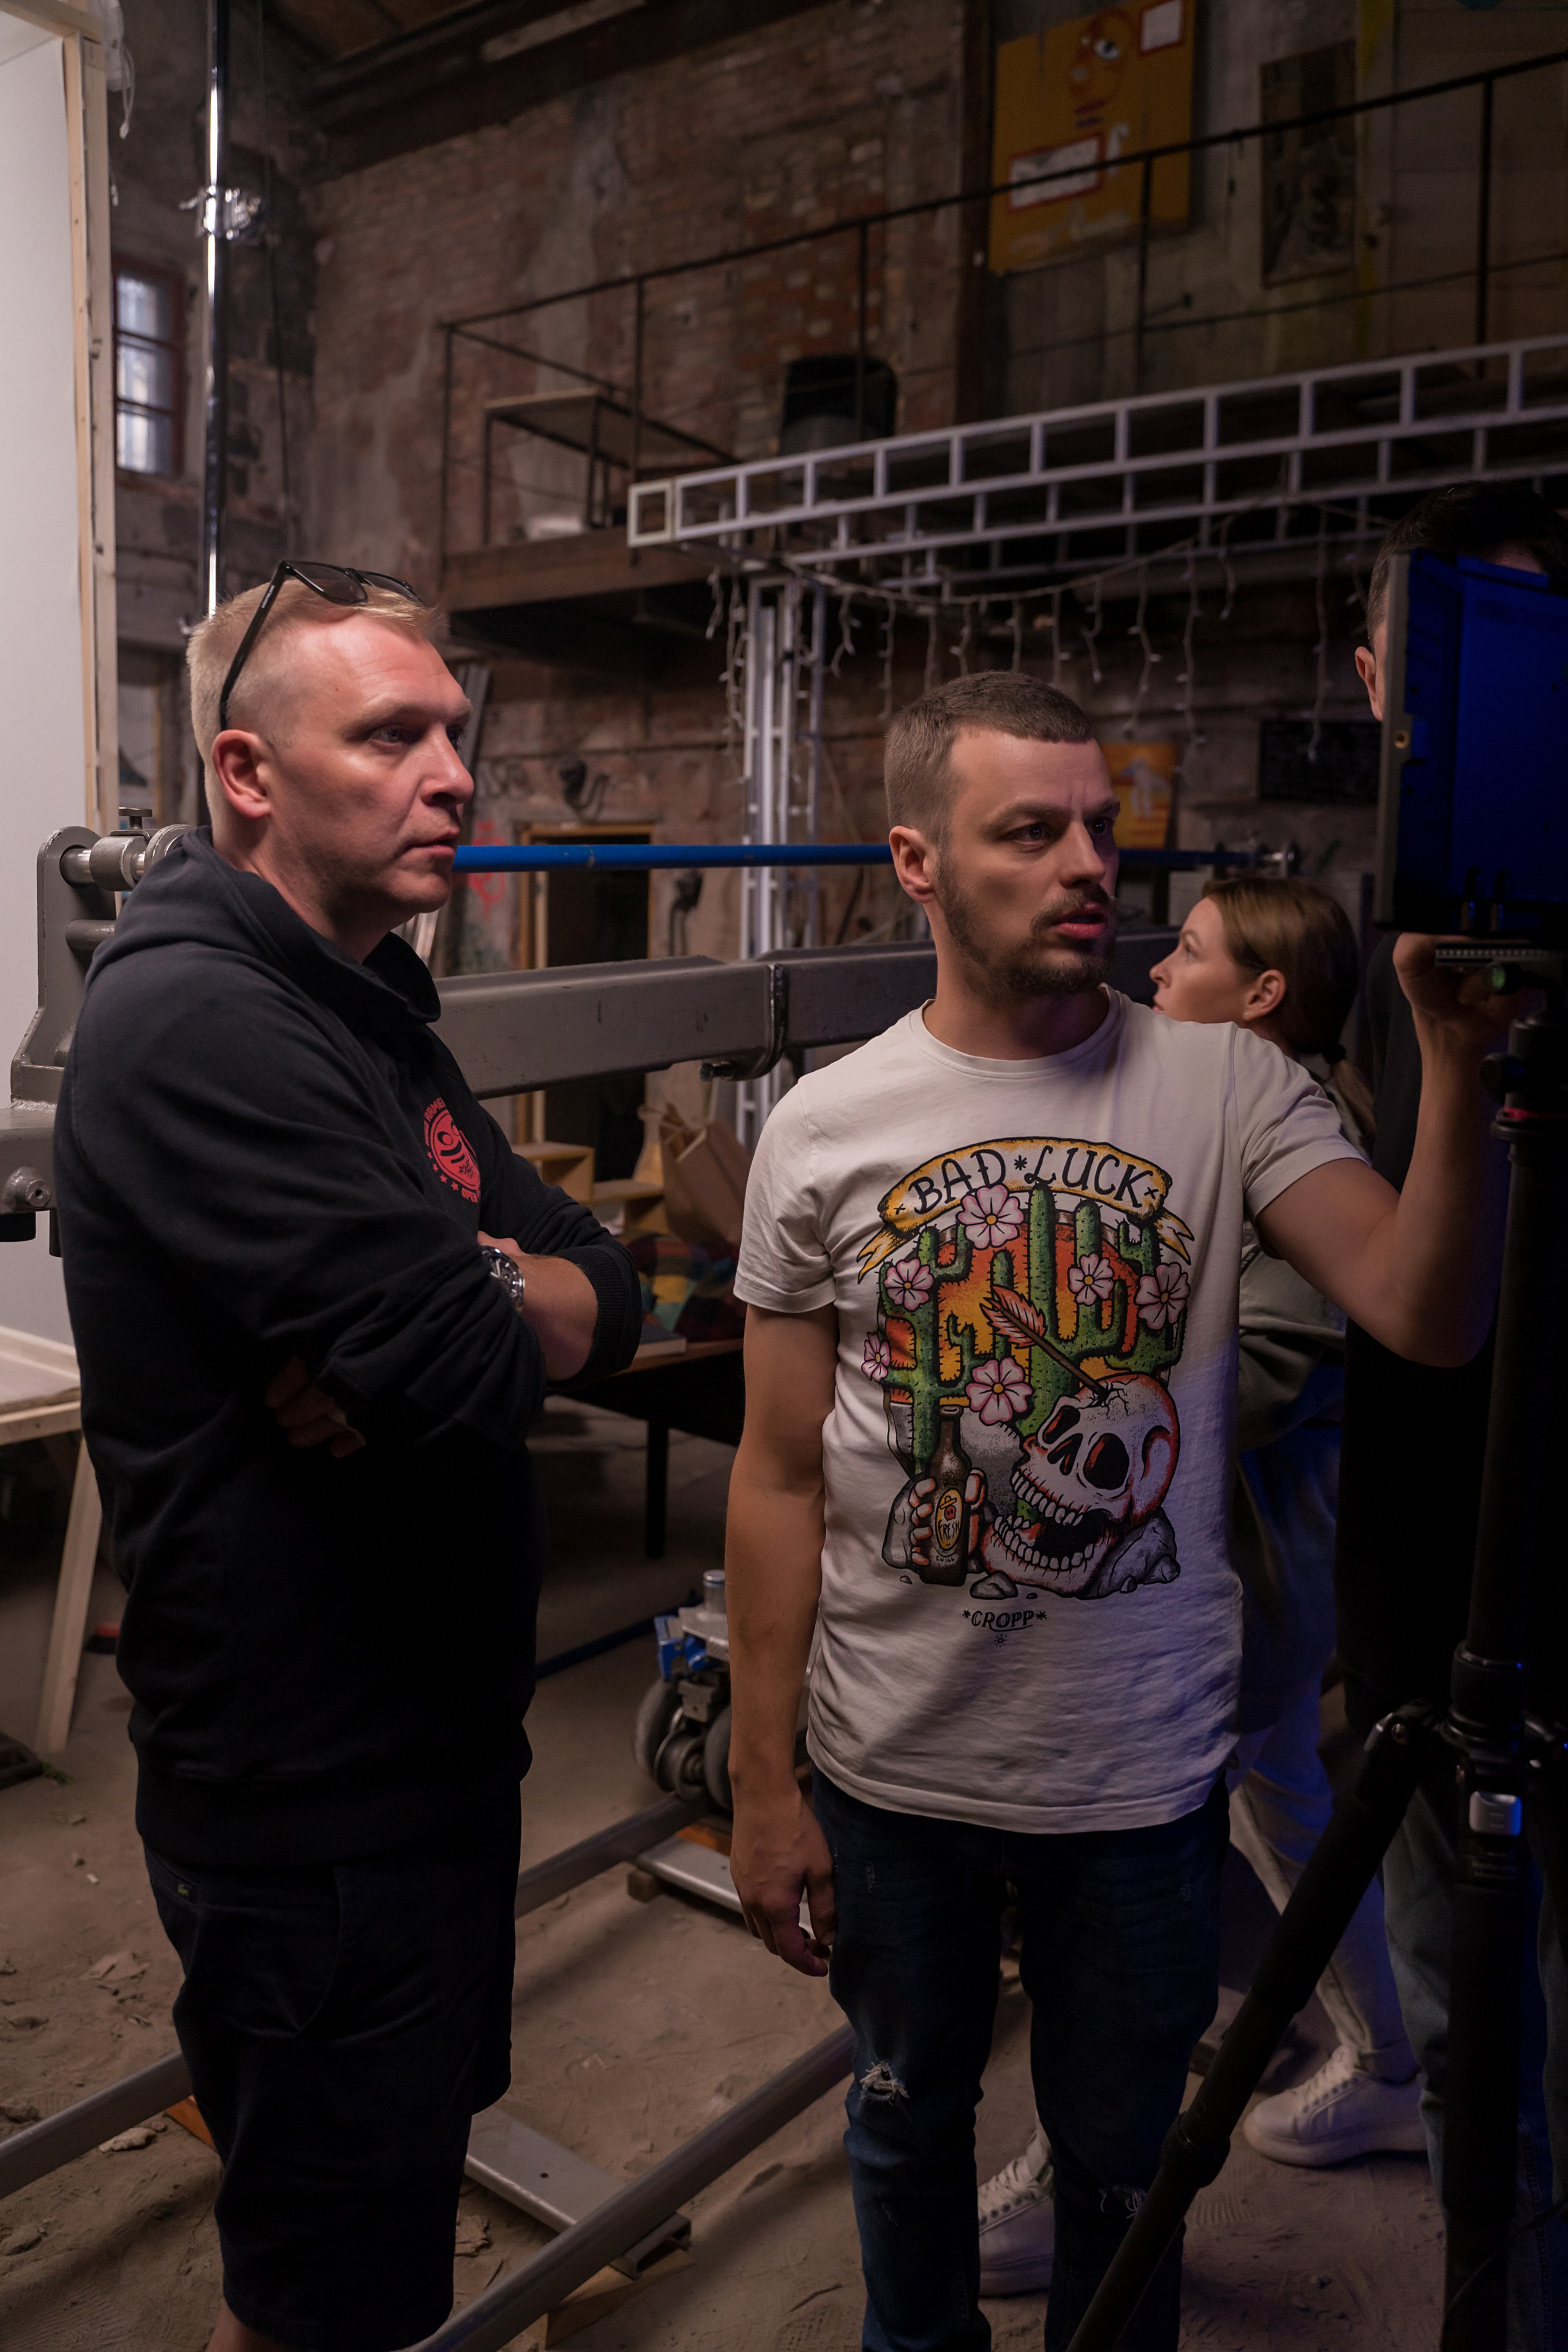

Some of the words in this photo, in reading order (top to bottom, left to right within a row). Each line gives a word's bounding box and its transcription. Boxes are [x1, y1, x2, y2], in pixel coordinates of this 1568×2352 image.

[908, 1148, 1006, 1215] BAD
[1024, 1145, 1154, 1208] LUCK
[938, 1519, 960, 1544] FRESH
